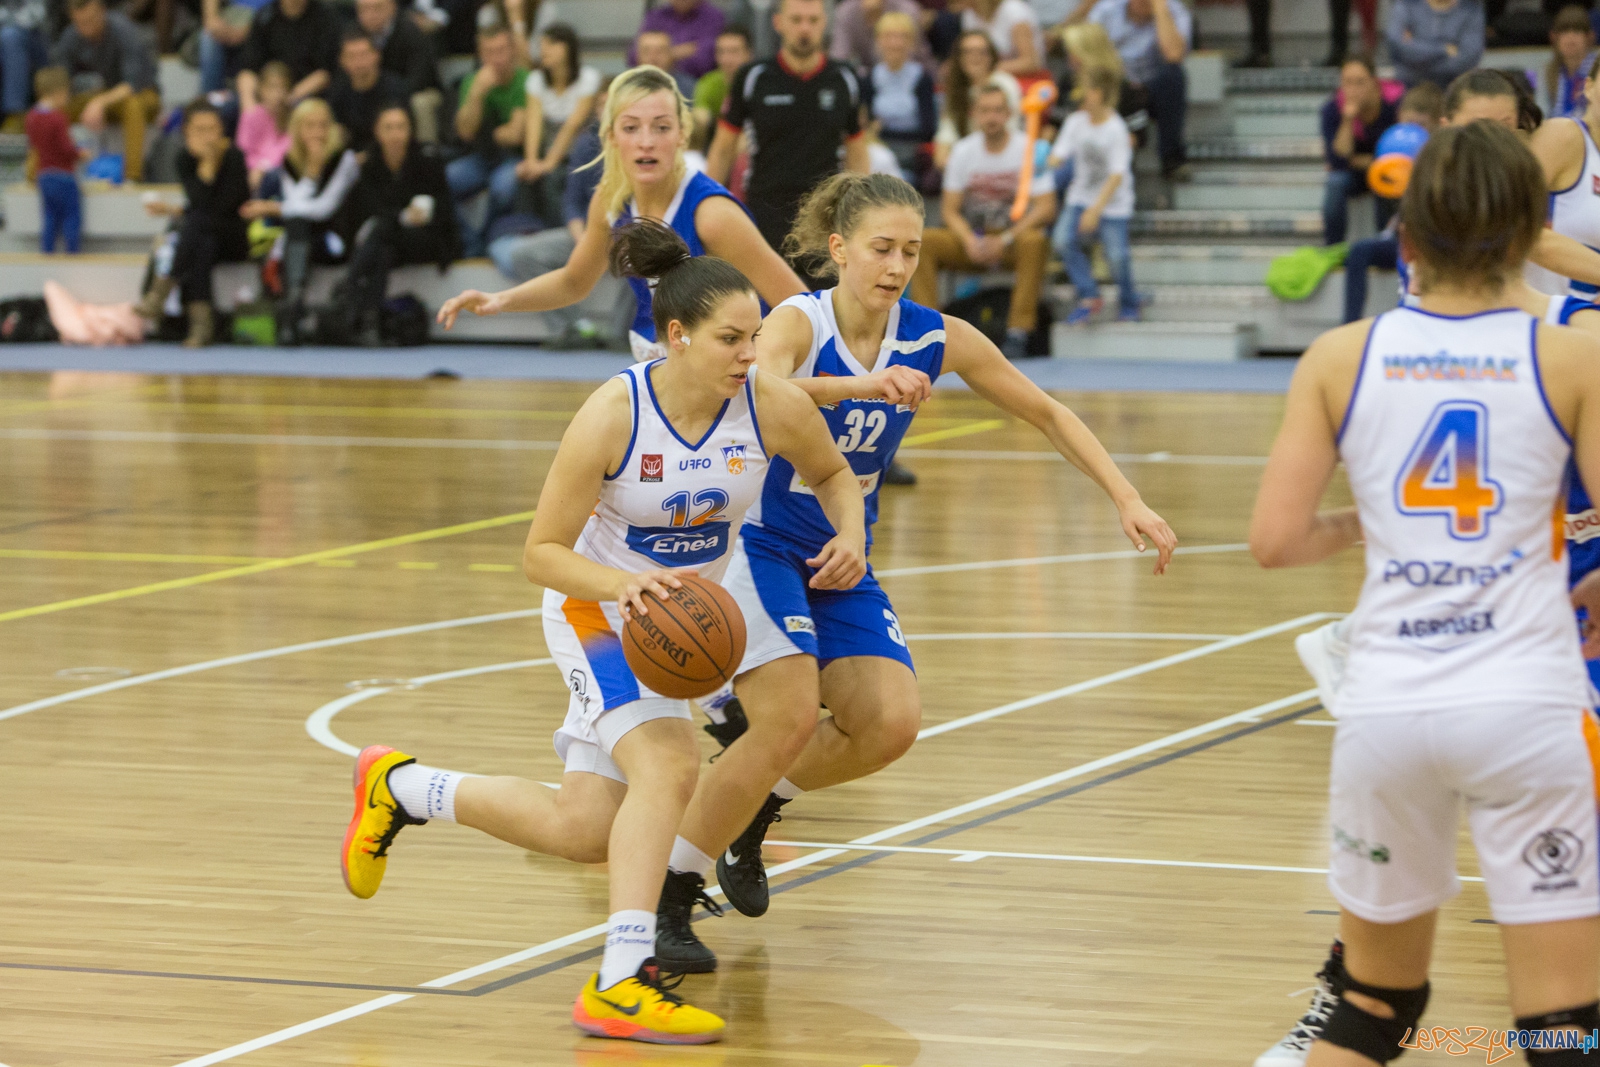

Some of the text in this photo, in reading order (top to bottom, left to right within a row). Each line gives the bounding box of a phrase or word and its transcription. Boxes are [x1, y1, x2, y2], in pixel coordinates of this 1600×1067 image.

[836, 408, 887, 453] 32
[1393, 399, 1505, 541] 4
[661, 487, 730, 528] 12
[651, 535, 719, 554] Enea
[883, 608, 907, 649] 3
